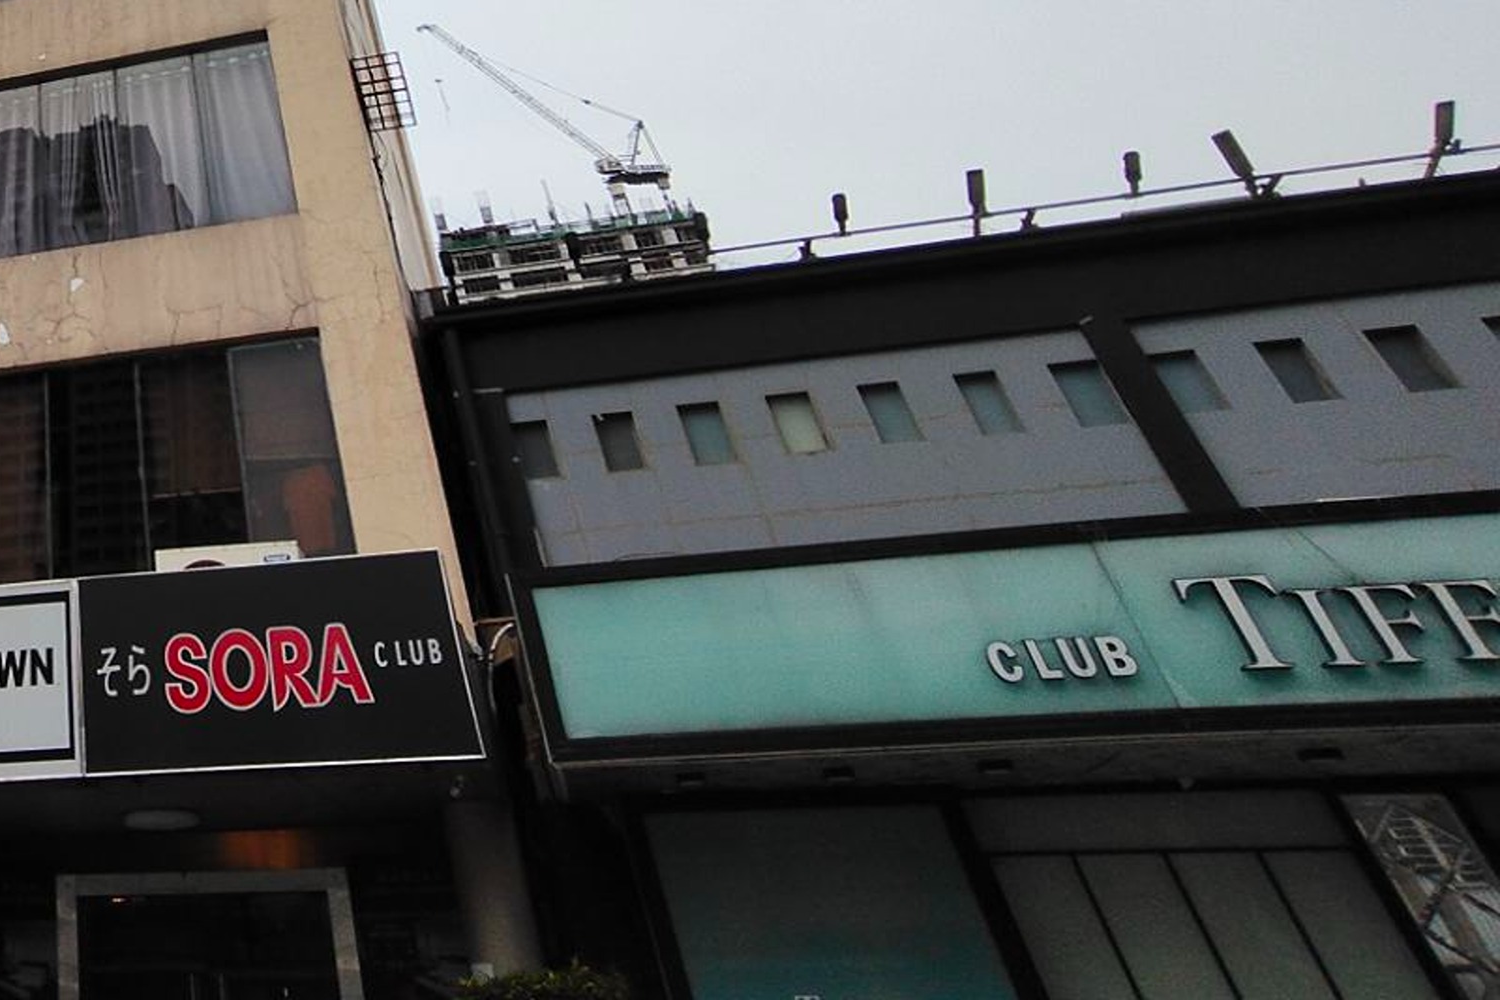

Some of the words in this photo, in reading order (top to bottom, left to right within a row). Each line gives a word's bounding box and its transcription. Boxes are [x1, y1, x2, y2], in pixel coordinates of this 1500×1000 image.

[97, 645, 150, 697] そら
[164, 622, 376, 714] SORA
[374, 638, 443, 668] CLUB
[986, 636, 1139, 683] CLUB
[1172, 574, 1500, 672] TIFF
